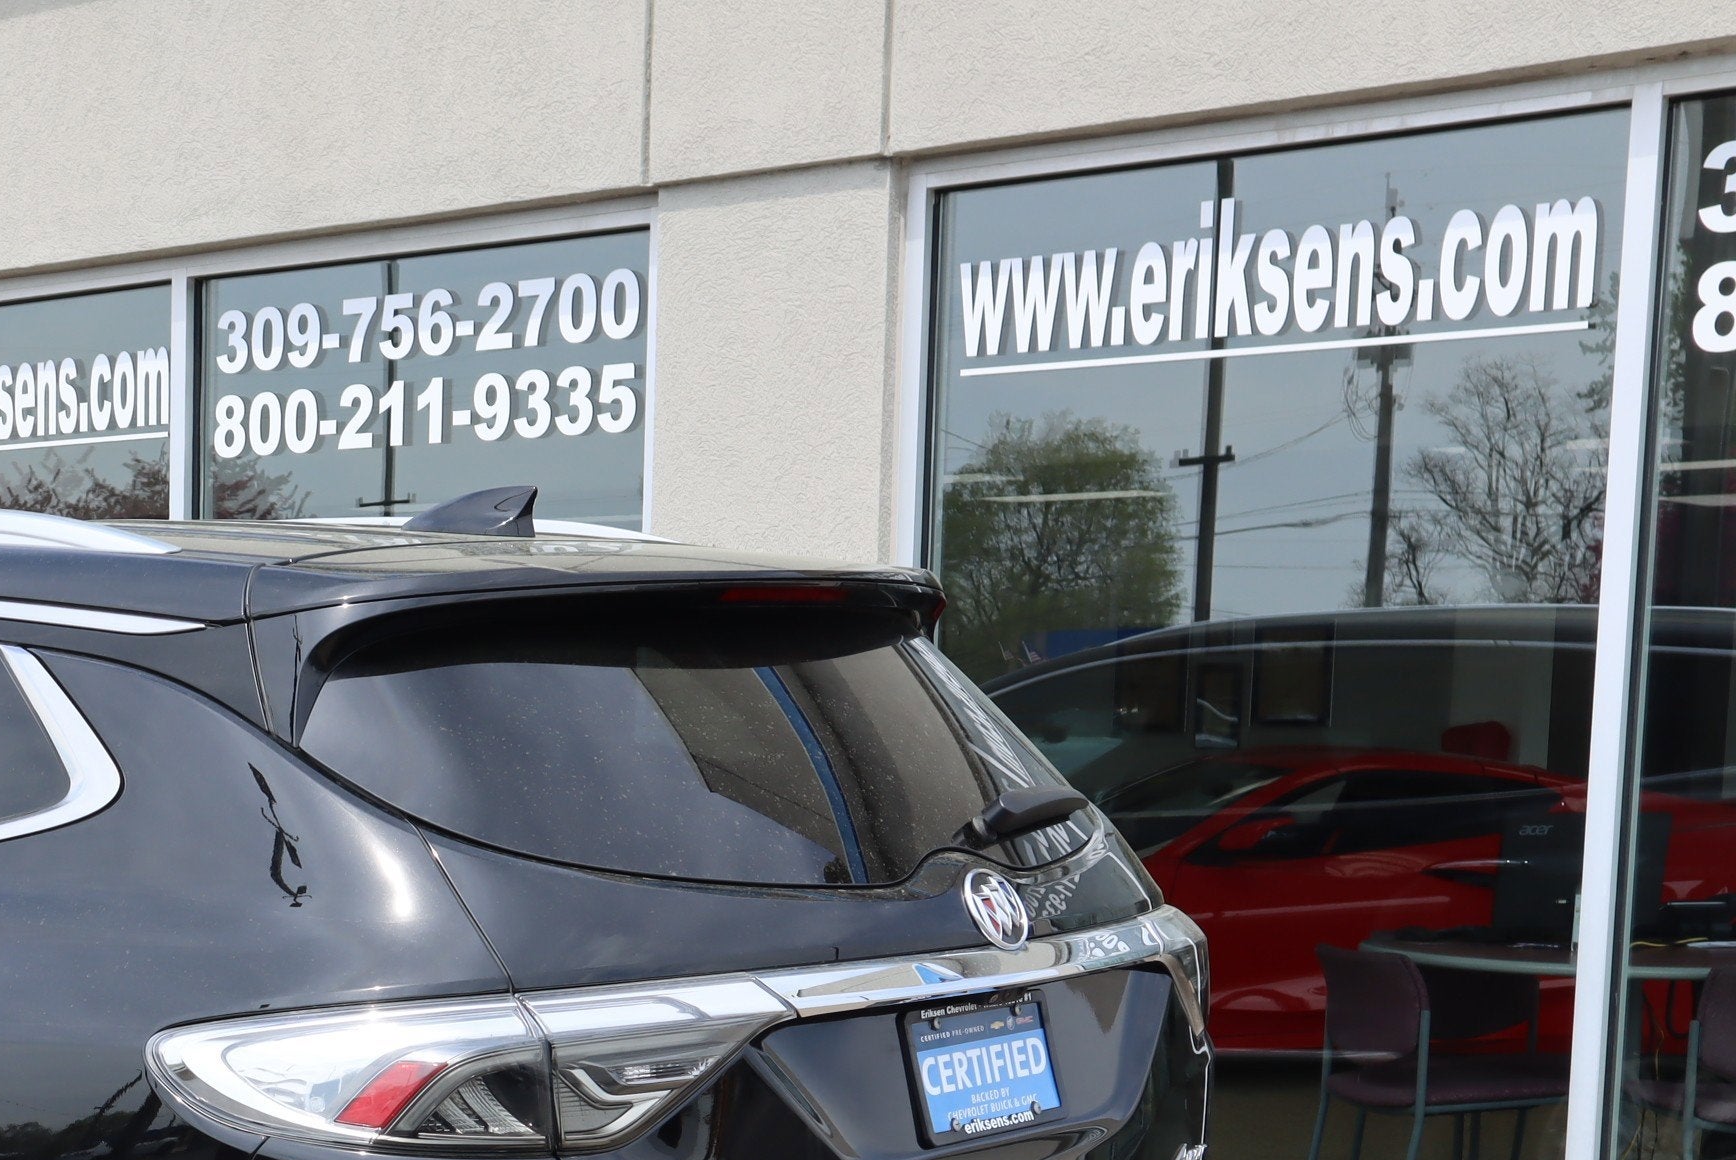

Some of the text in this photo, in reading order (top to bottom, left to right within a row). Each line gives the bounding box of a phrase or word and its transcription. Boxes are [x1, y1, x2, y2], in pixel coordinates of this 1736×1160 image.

[960, 196, 1599, 357] www.eriksens.com
[217, 268, 641, 374] 309-756-2700
[213, 363, 637, 459] 800-211-9335
[1518, 825, 1554, 836] acer
[920, 1007, 945, 1019] Eriksen
[946, 1003, 977, 1015] Chevrolet
[920, 1025, 985, 1043] CERTIFIED PRE-OWNED
[921, 1037, 1047, 1096] CERTIFIED
[971, 1087, 1010, 1104] BACKED BY
[947, 1104, 989, 1121] CHEVROLET
[990, 1099, 1014, 1113] BUICK
[964, 1111, 1034, 1134] eriksens.com
